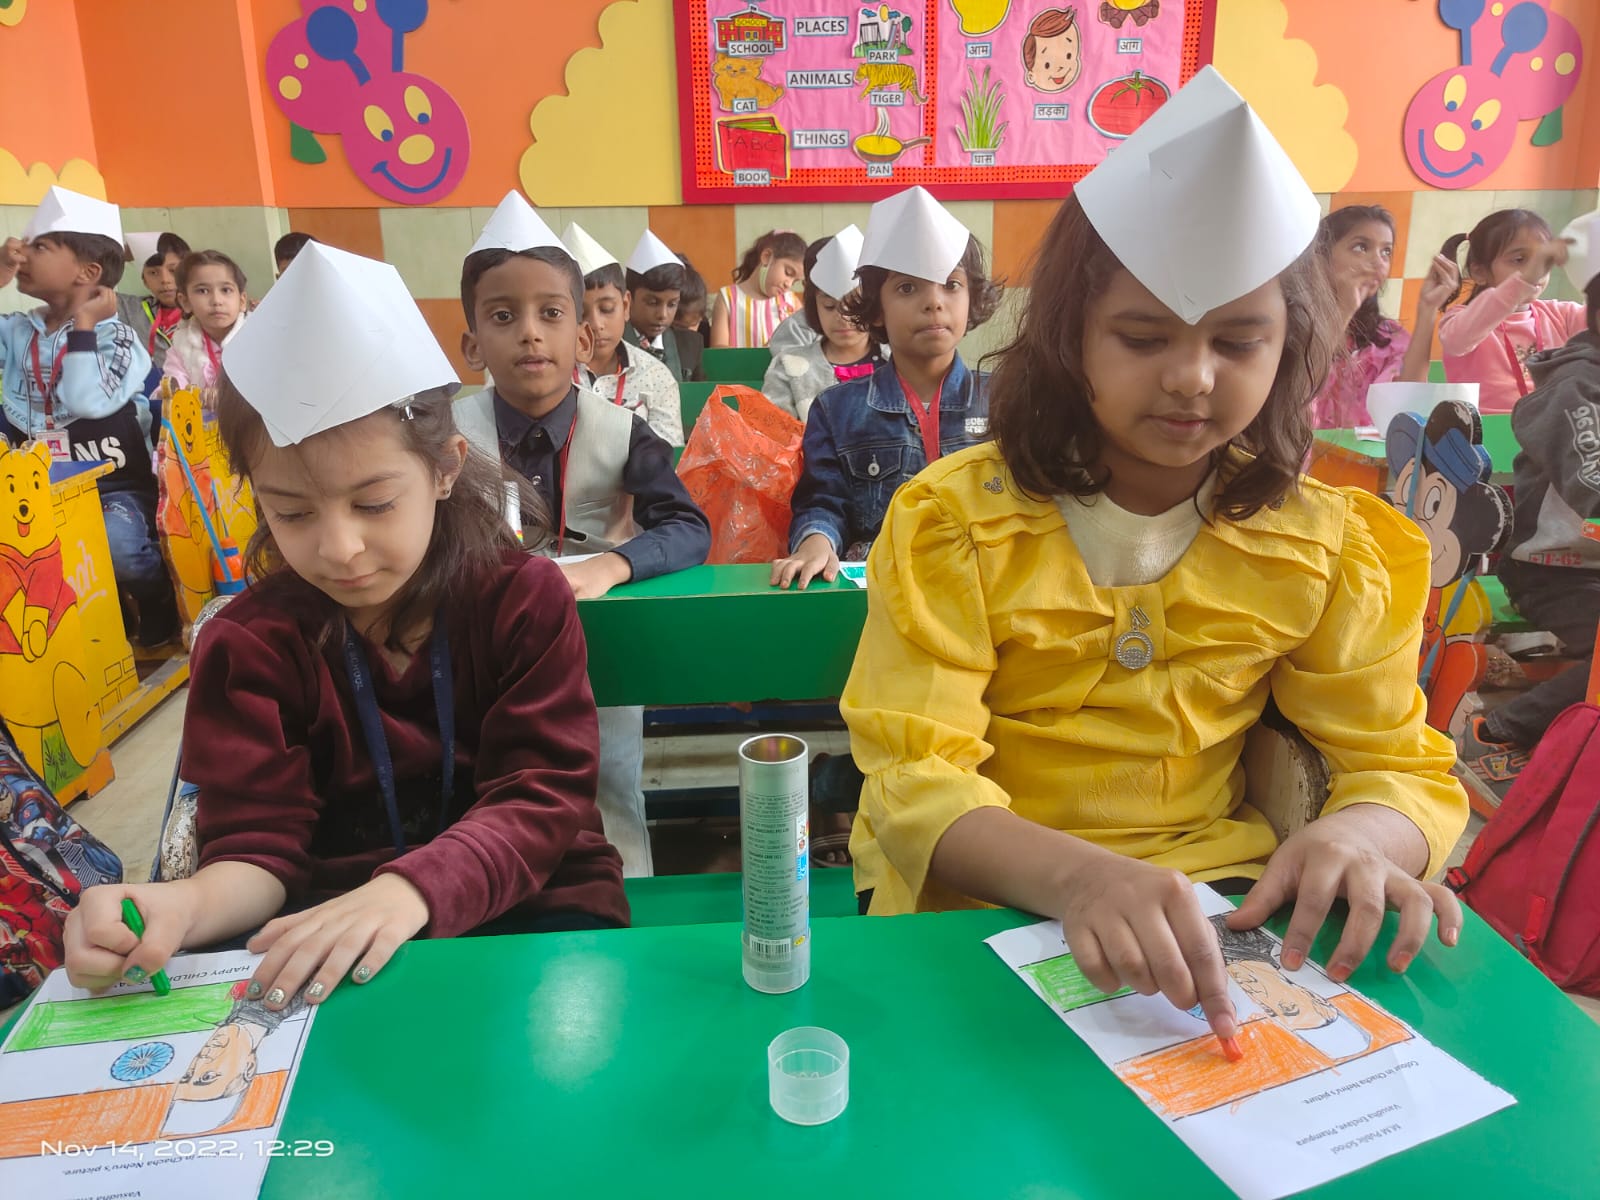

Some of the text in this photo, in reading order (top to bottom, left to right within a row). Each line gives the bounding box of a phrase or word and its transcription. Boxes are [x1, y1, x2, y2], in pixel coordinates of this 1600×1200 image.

[737, 18, 765, 26] SCHOOL
[796, 20, 845, 33] PLACES
[730, 43, 773, 54] SCHOOL
[969, 45, 989, 55] आम
[1119, 41, 1139, 51] आग
[869, 51, 896, 61] PARK
[789, 73, 851, 86] ANIMALS
[872, 94, 901, 104] TIGER
[735, 101, 755, 111] CAT
[795, 132, 846, 146] THINGS
[974, 154, 993, 164] घास
[869, 165, 890, 175] PAN
[738, 172, 768, 183] BOOK
[211, 965, 250, 977] HAPPY
[104, 1161, 144, 1172] Nehru's
[147, 1156, 183, 1167] Chacha
